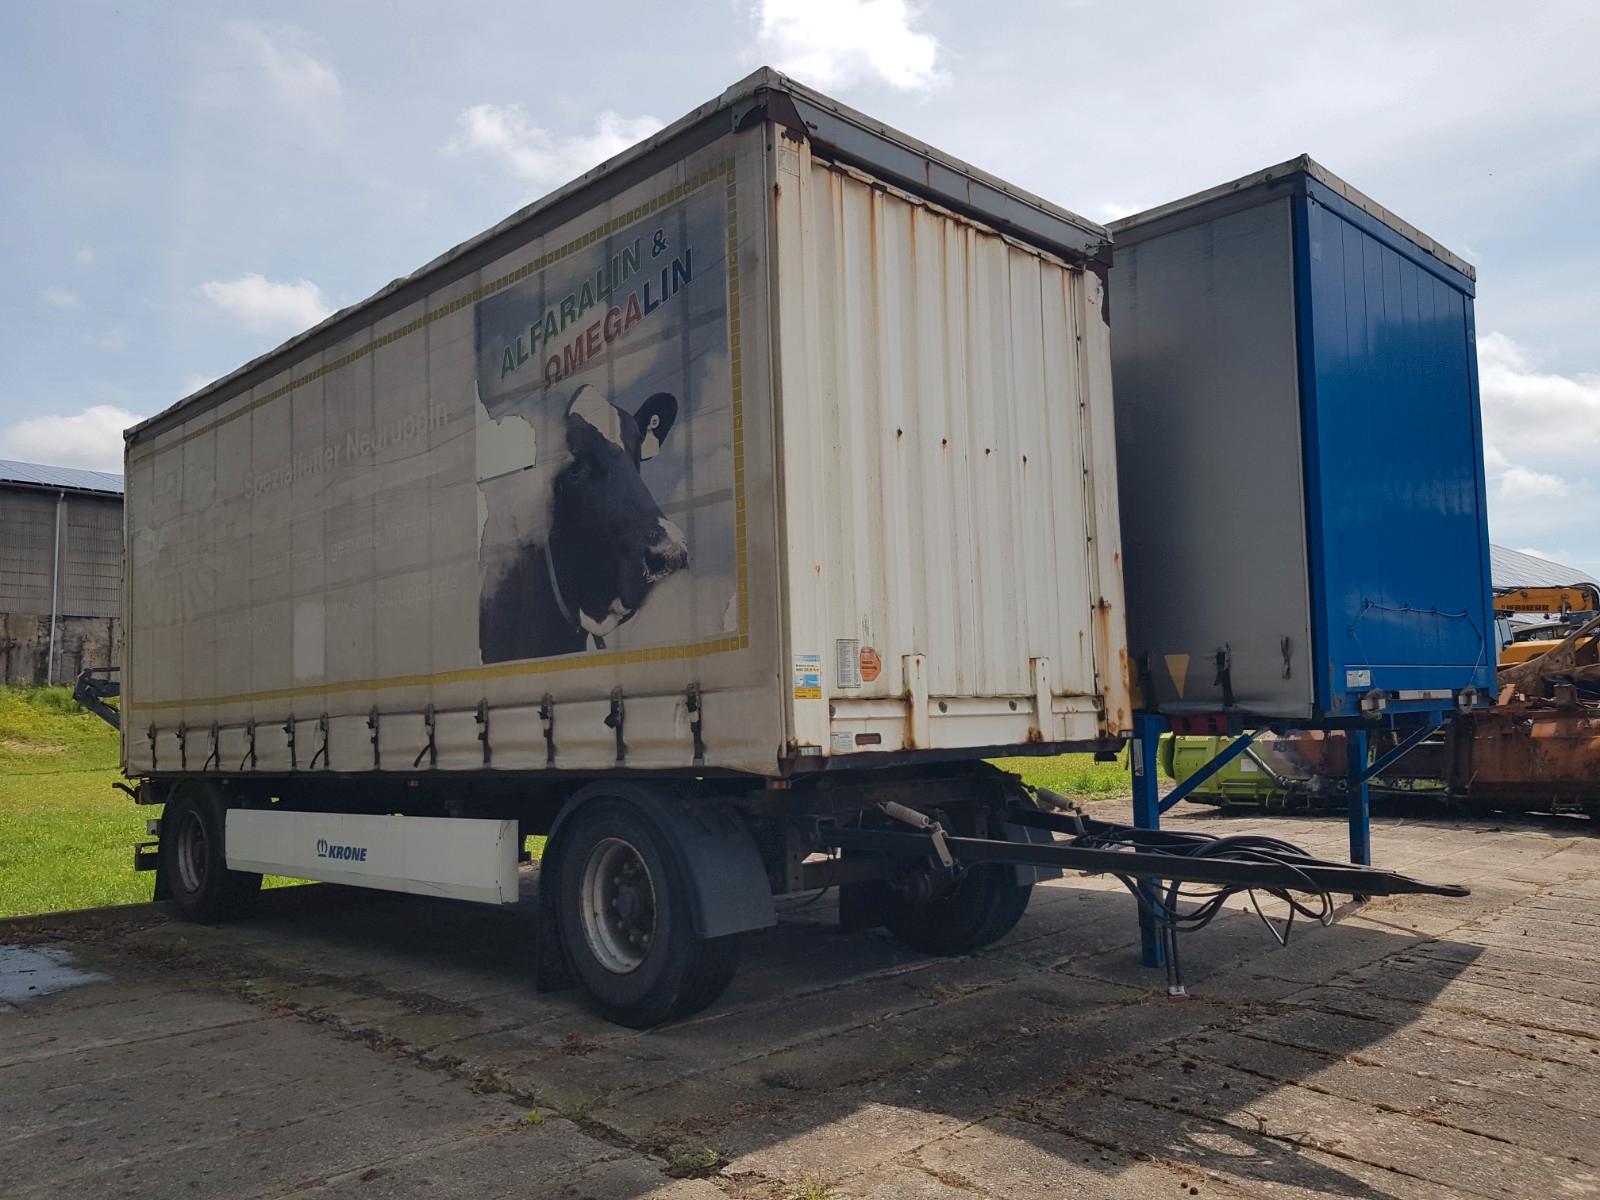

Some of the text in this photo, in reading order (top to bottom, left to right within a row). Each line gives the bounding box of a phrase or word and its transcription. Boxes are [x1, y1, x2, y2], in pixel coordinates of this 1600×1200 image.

[501, 228, 669, 380] ALFARALIN &
[345, 397, 448, 463] Neuruppin
[328, 844, 368, 862] KRONE
